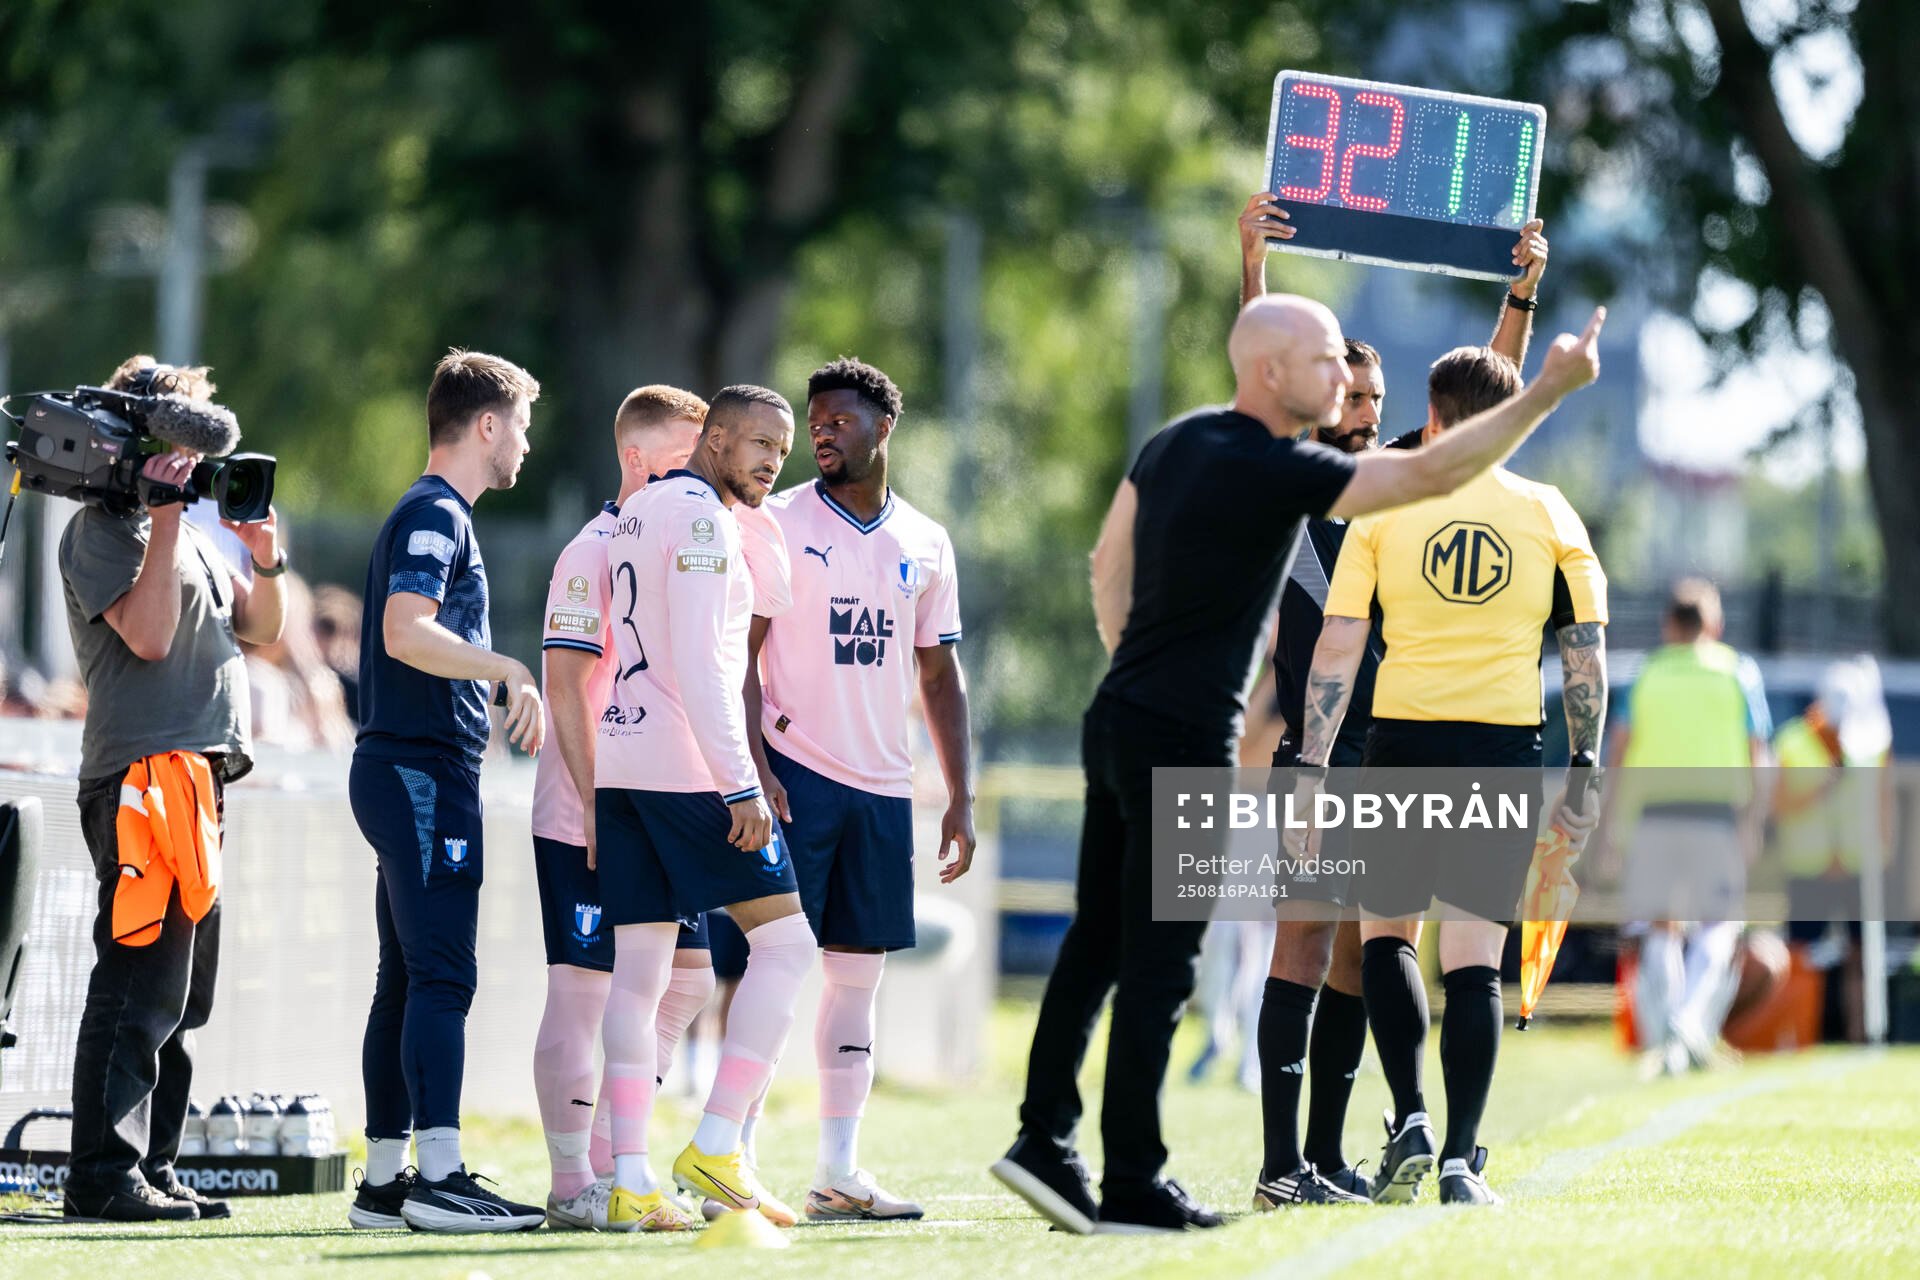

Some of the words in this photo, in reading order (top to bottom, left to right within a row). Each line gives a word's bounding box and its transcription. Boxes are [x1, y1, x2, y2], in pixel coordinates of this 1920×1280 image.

[1279, 84, 1404, 211] 32
[1448, 112, 1533, 224] 11
[682, 554, 723, 568] UNIBET
[1431, 528, 1504, 596] MG
[554, 614, 594, 628] UNIBET
[176, 1168, 278, 1190] macron
